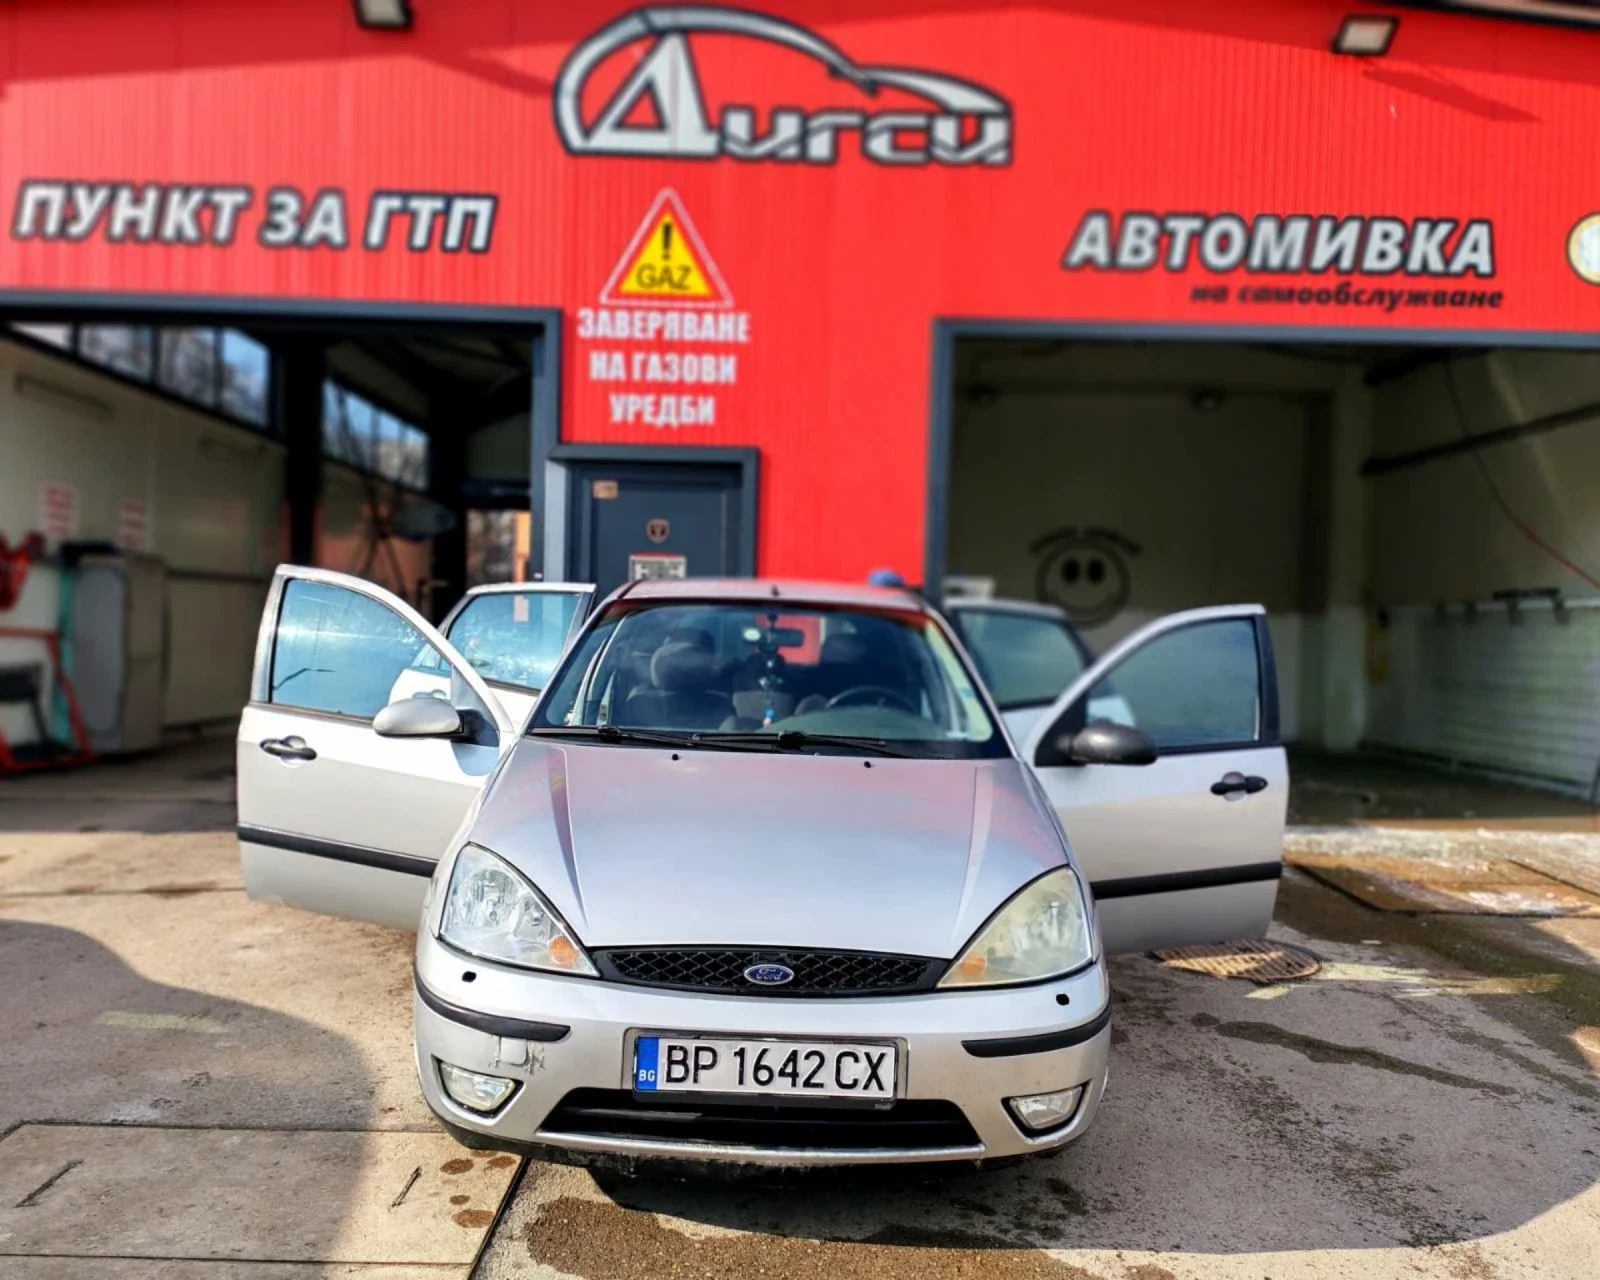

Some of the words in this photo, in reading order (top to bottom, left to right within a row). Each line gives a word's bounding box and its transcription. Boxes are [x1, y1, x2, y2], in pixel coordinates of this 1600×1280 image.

[13, 181, 251, 242] ПУНКТ
[260, 187, 348, 247] ЗА
[364, 190, 497, 252] ГТП
[1063, 210, 1496, 277] АВТОМИВКА
[636, 263, 692, 291] GAZ
[1191, 286, 1229, 304] на
[1237, 281, 1503, 312] самообслужване
[577, 308, 751, 343] ЗАВЕРЯВАНЕ
[589, 351, 626, 381] НА
[631, 352, 737, 384] ГАЗОВИ
[608, 393, 716, 427] УРЕДБИ
[638, 1069, 655, 1083] BG
[733, 1047, 825, 1089] 1642
